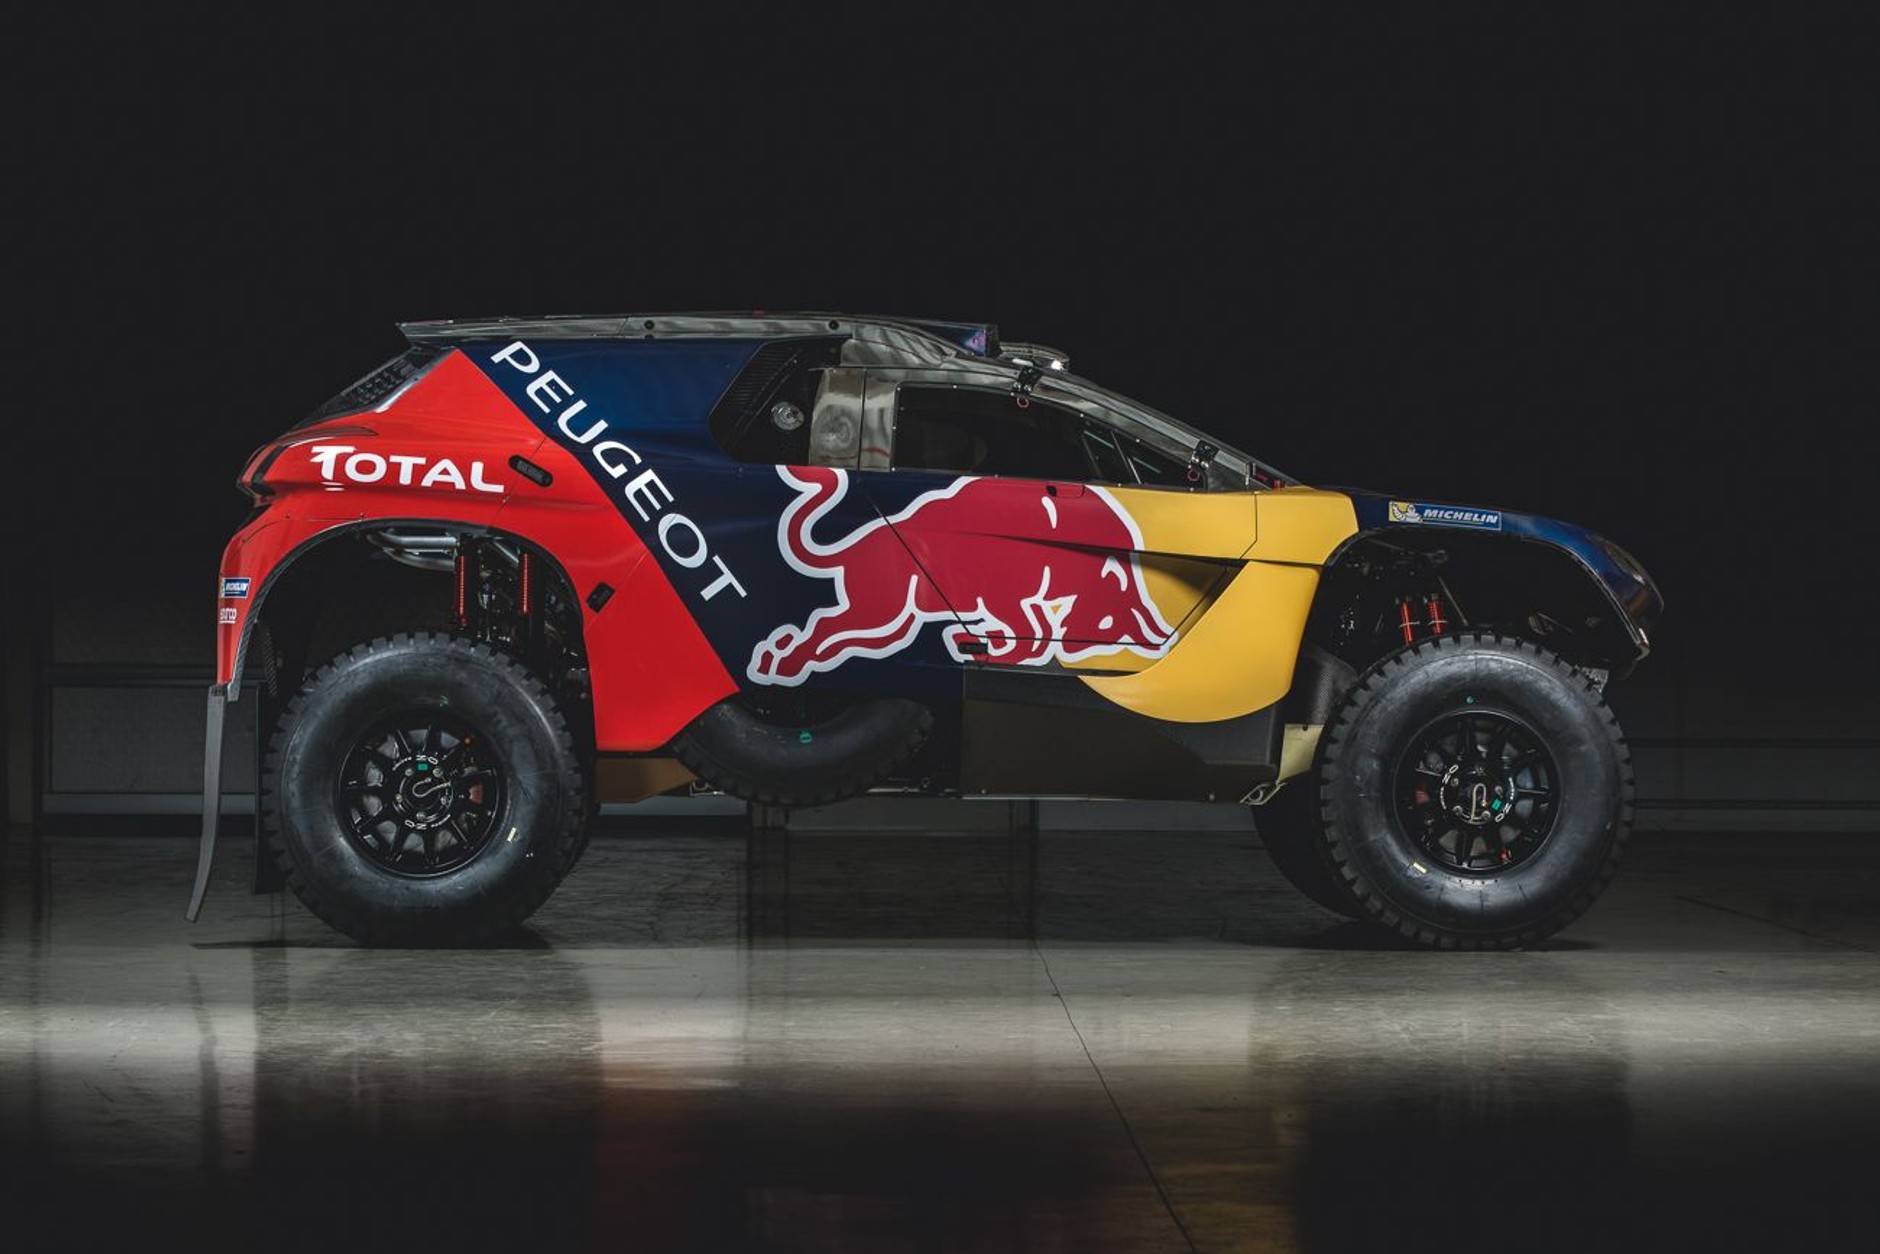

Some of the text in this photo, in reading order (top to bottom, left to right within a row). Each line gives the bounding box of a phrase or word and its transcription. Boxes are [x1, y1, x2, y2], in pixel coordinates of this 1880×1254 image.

[310, 445, 505, 493] TOTAL
[490, 341, 748, 601] PEUGEOT
[1424, 509, 1499, 524] MICHELIN
